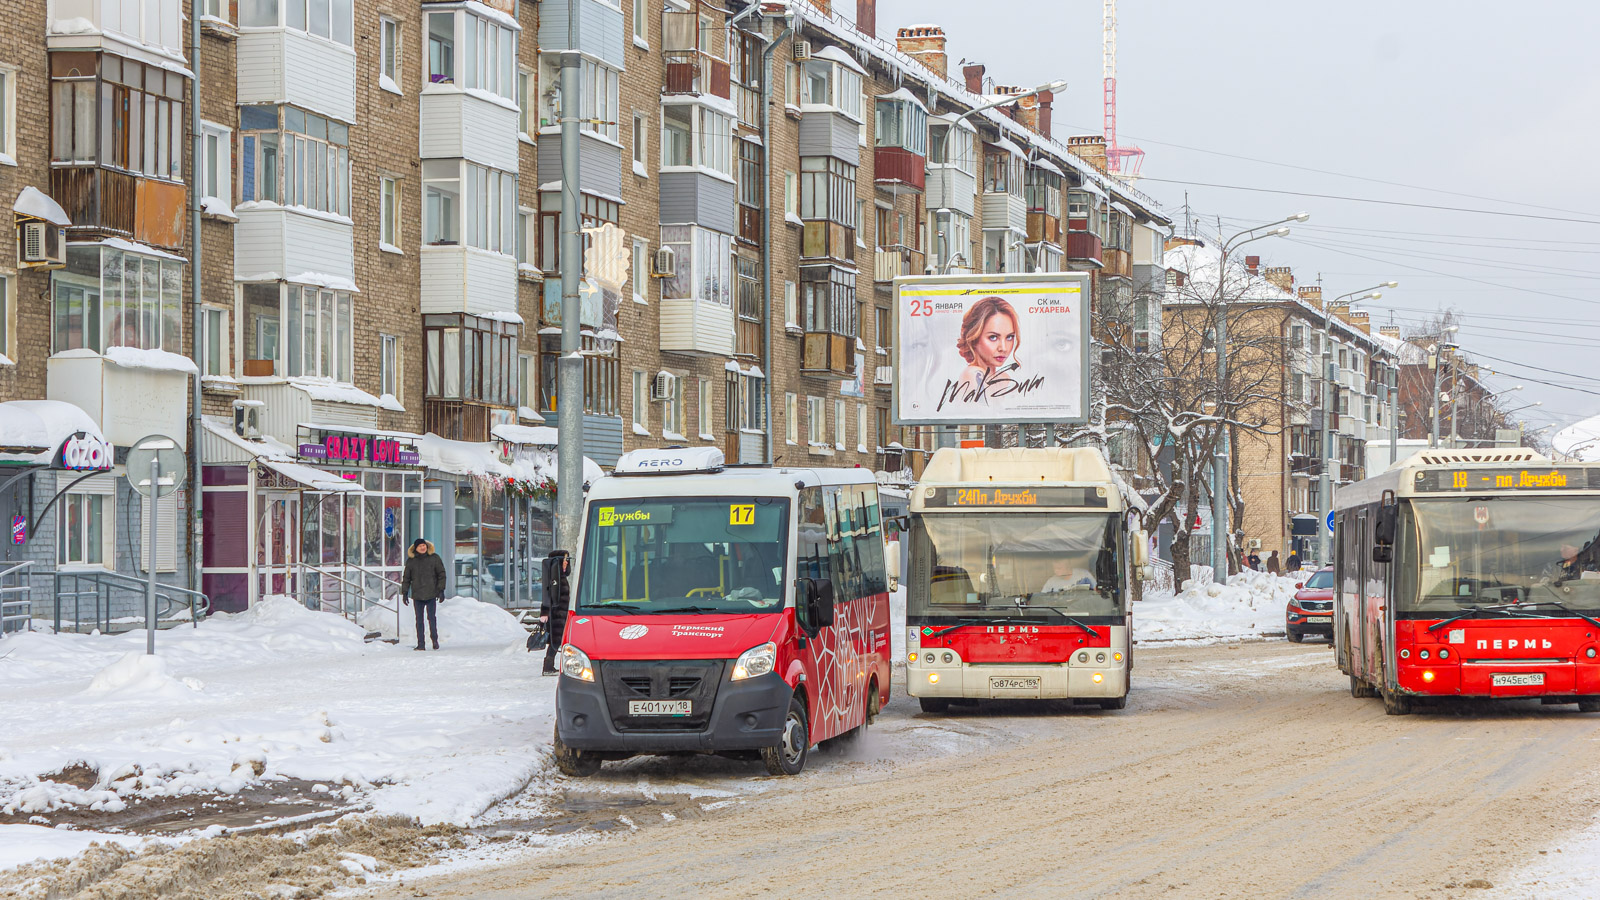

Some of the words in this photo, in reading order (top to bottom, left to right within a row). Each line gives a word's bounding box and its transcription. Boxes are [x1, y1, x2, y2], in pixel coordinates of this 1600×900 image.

[1037, 298, 1048, 306] СК
[910, 299, 933, 317] 25
[935, 302, 963, 310] ЯНВАРЯ
[1028, 305, 1071, 314] СУХАРЕВА
[63, 439, 114, 469] OZON
[326, 435, 367, 460] CRAZY
[373, 439, 400, 463] LOVE
[638, 458, 683, 468] AERO
[1453, 471, 1468, 488] 18
[600, 511, 613, 522] 17
[613, 509, 650, 524] ружбы
[732, 506, 754, 523] 17
[671, 630, 723, 639] Транспорт
[986, 625, 1039, 633] ПЕРМЬ
[1476, 638, 1552, 650] ПЕРМЬ
[994, 679, 1024, 688] О874РС
[1025, 679, 1037, 687] 159
[1529, 674, 1542, 682] 159
[633, 702, 675, 713] Е401УУ
[677, 701, 688, 710] 18
